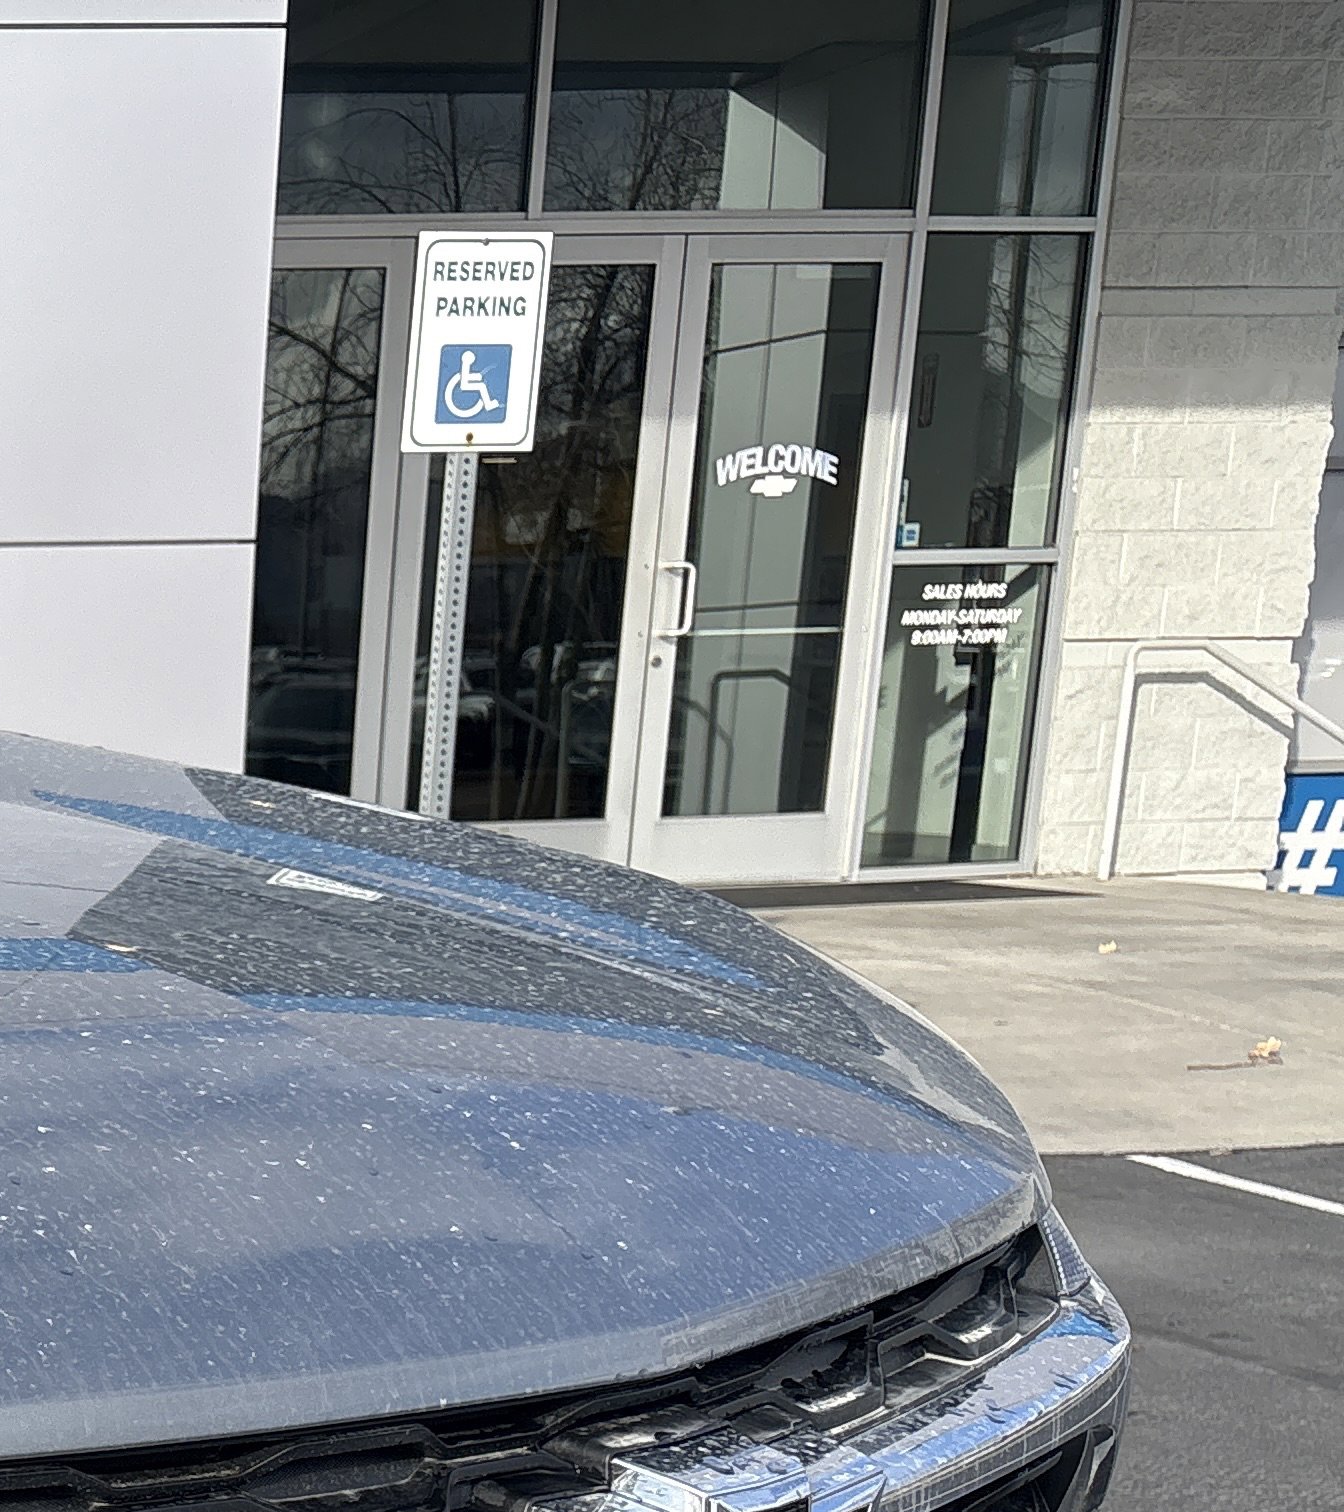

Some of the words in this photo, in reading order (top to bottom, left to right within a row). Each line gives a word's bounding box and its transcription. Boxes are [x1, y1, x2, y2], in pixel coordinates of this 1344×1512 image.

[433, 261, 534, 281] RESERVED
[436, 296, 526, 316] PARKING
[716, 444, 838, 486] WELCOME
[922, 583, 962, 599] SALES
[964, 583, 1007, 598] HOURS
[901, 609, 1022, 625] MONDAY-SATURDAY
